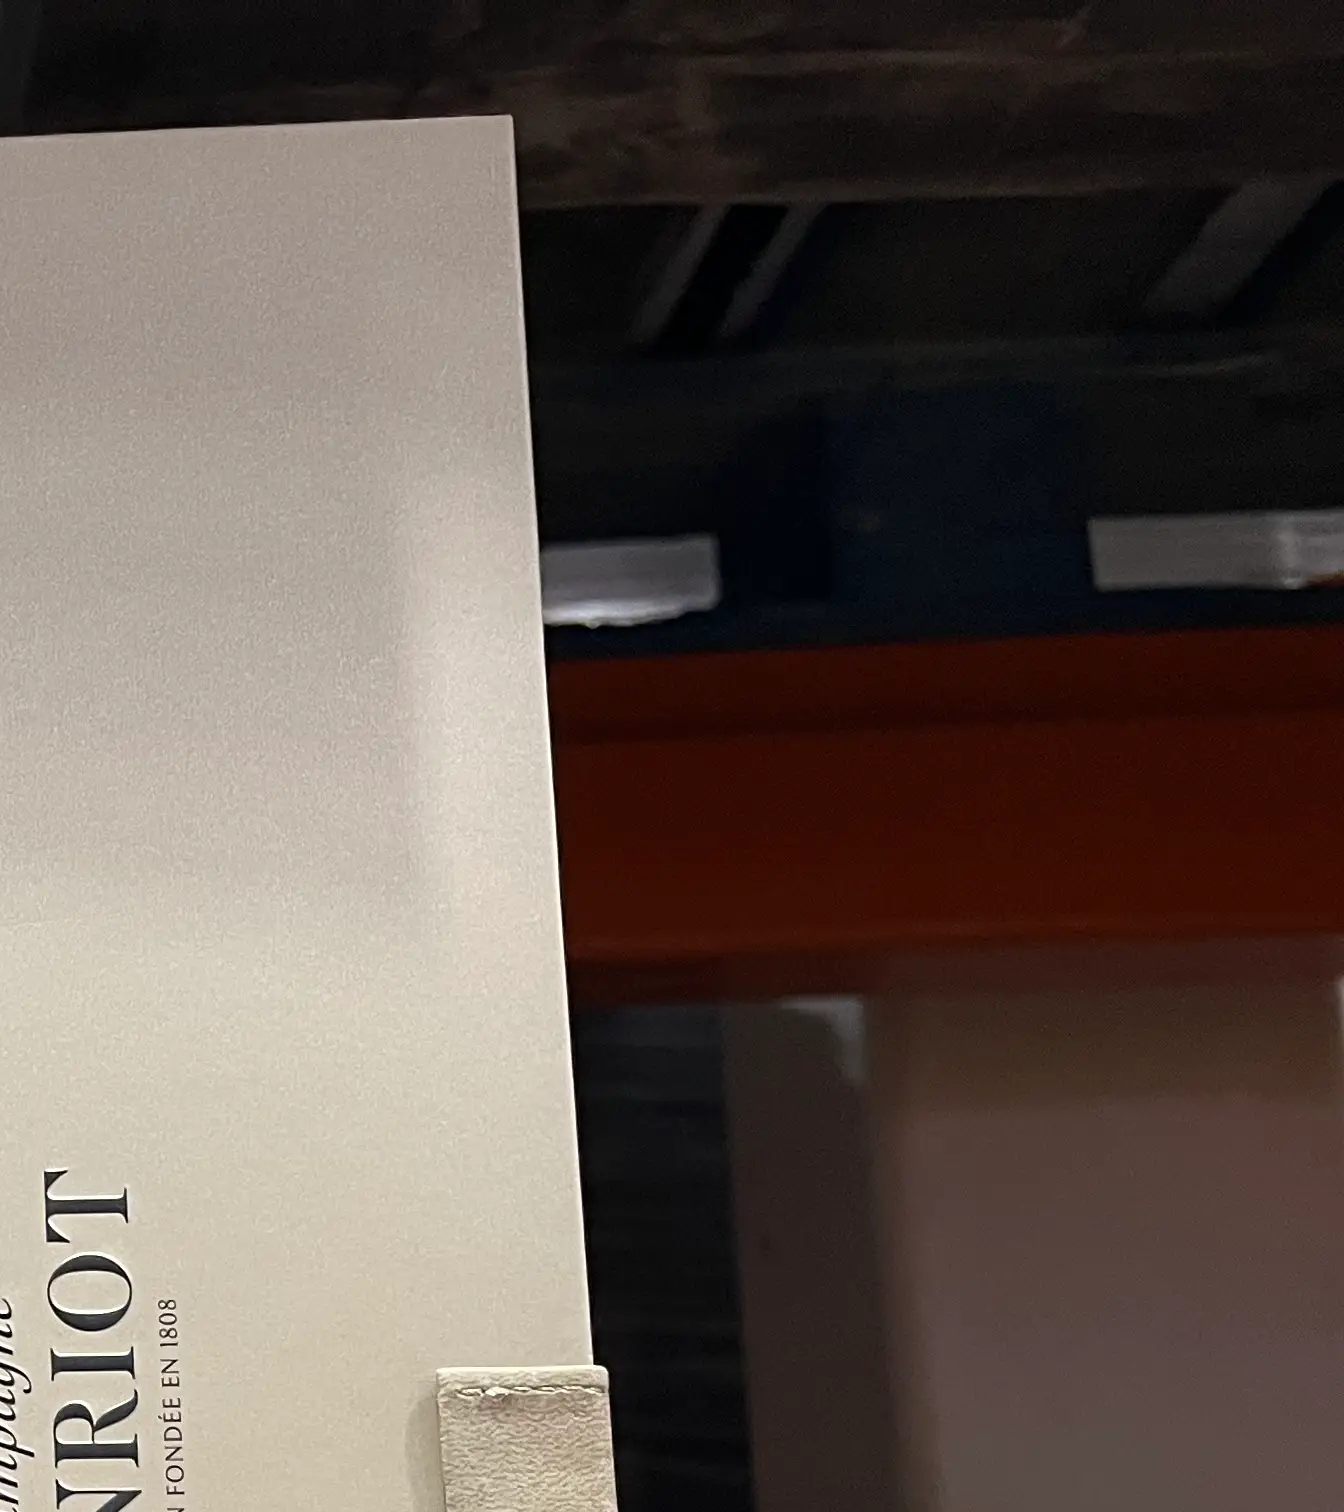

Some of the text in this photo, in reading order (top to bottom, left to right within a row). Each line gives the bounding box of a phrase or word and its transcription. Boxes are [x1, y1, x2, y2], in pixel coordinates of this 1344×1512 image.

[157, 1298, 179, 1348] 1808
[159, 1357, 181, 1388] EN
[157, 1396, 187, 1496] FONDÉE
